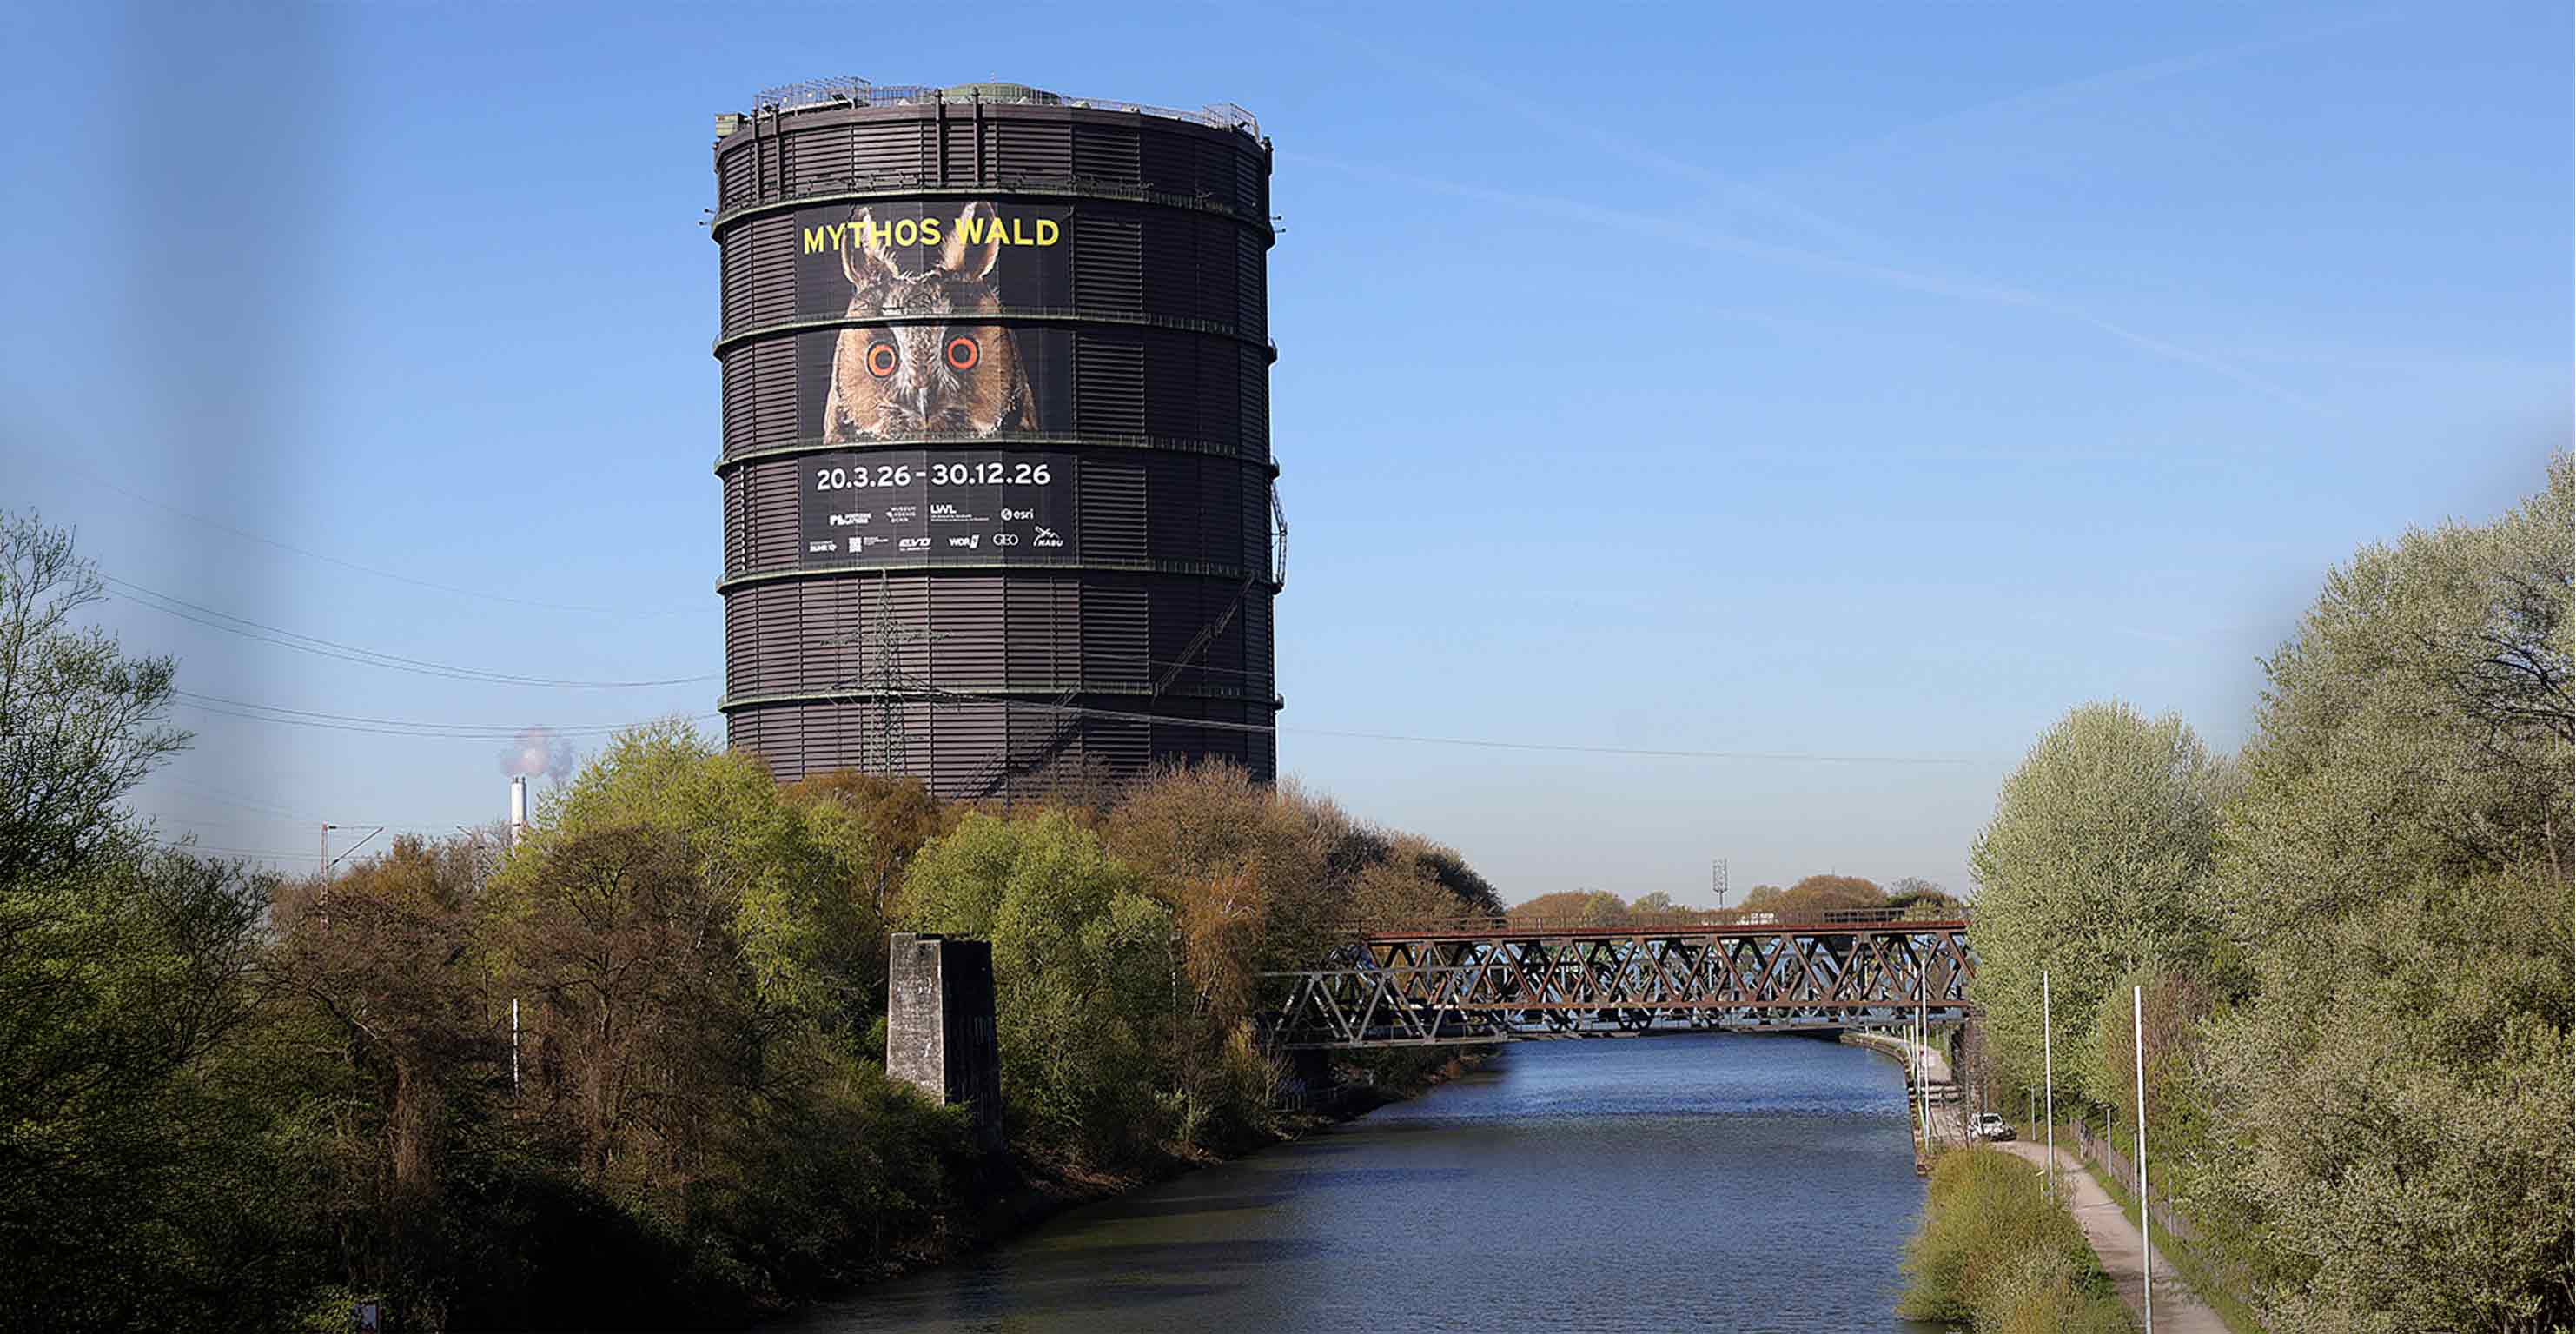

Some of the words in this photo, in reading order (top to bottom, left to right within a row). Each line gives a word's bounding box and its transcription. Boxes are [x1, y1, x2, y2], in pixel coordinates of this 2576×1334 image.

[804, 218, 943, 255] MYTHOS
[953, 217, 1060, 247] WALD
[817, 466, 911, 490] 20.3.26
[931, 463, 1050, 486] 30.12.26
[930, 504, 957, 514] LWL
[1014, 508, 1034, 520] esri
[993, 534, 1019, 546] GEO
